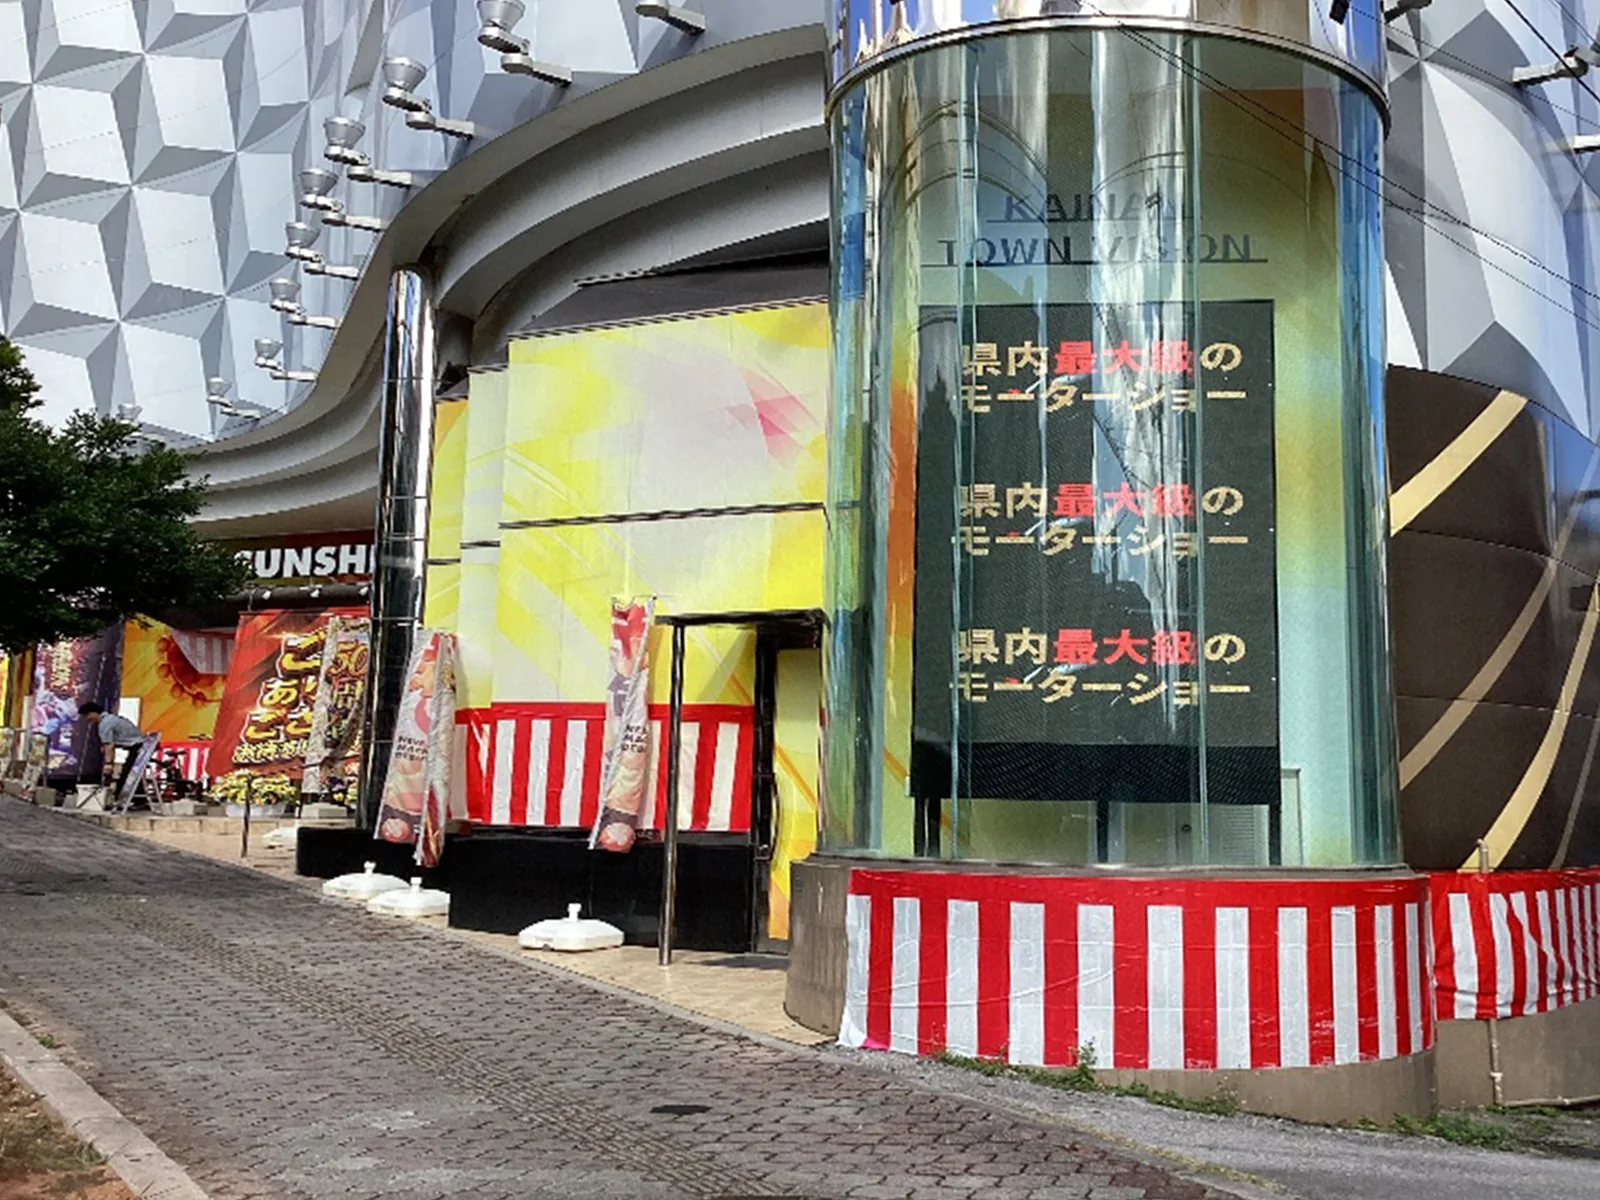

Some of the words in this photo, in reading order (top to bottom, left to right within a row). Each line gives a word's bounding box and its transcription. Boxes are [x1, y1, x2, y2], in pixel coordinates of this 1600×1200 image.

[938, 236, 1072, 266] TOWN
[1091, 233, 1251, 263] VION
[960, 340, 1243, 378] 県内最大級の
[960, 381, 1247, 413] モーターショー
[957, 482, 1244, 518] 県内最大級の
[951, 525, 1249, 557] モーターショー
[956, 627, 1246, 665] 県内最大級の
[950, 672, 1251, 706] モーターショー
